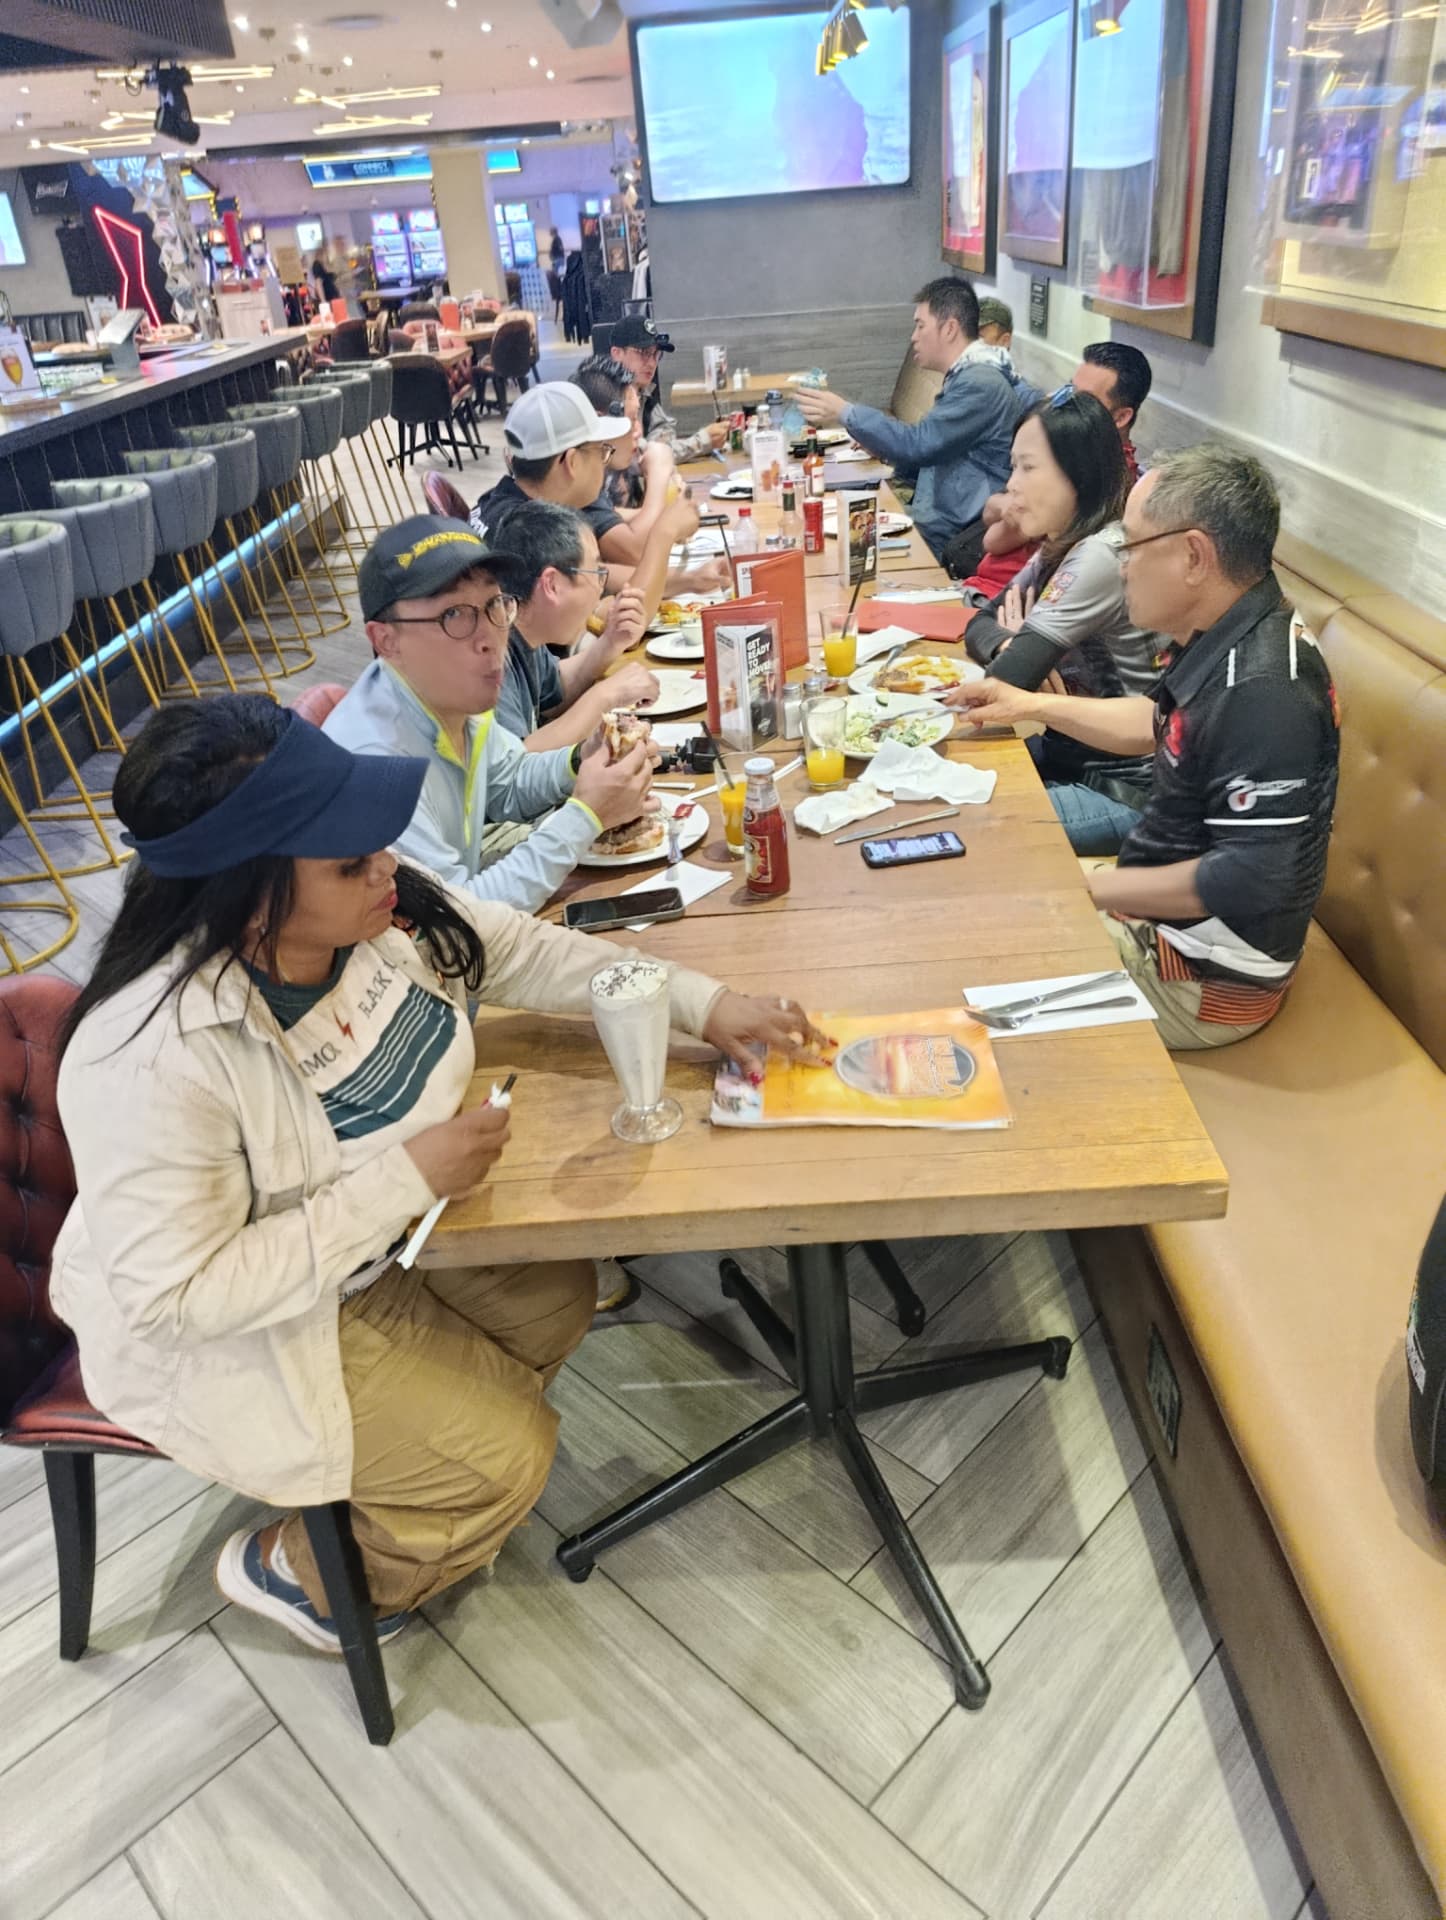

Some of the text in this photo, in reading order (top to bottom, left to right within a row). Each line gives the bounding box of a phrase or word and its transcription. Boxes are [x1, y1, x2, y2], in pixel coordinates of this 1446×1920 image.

[747, 638, 761, 650] GET
[748, 642, 771, 660] READY
[748, 658, 760, 668] TO
